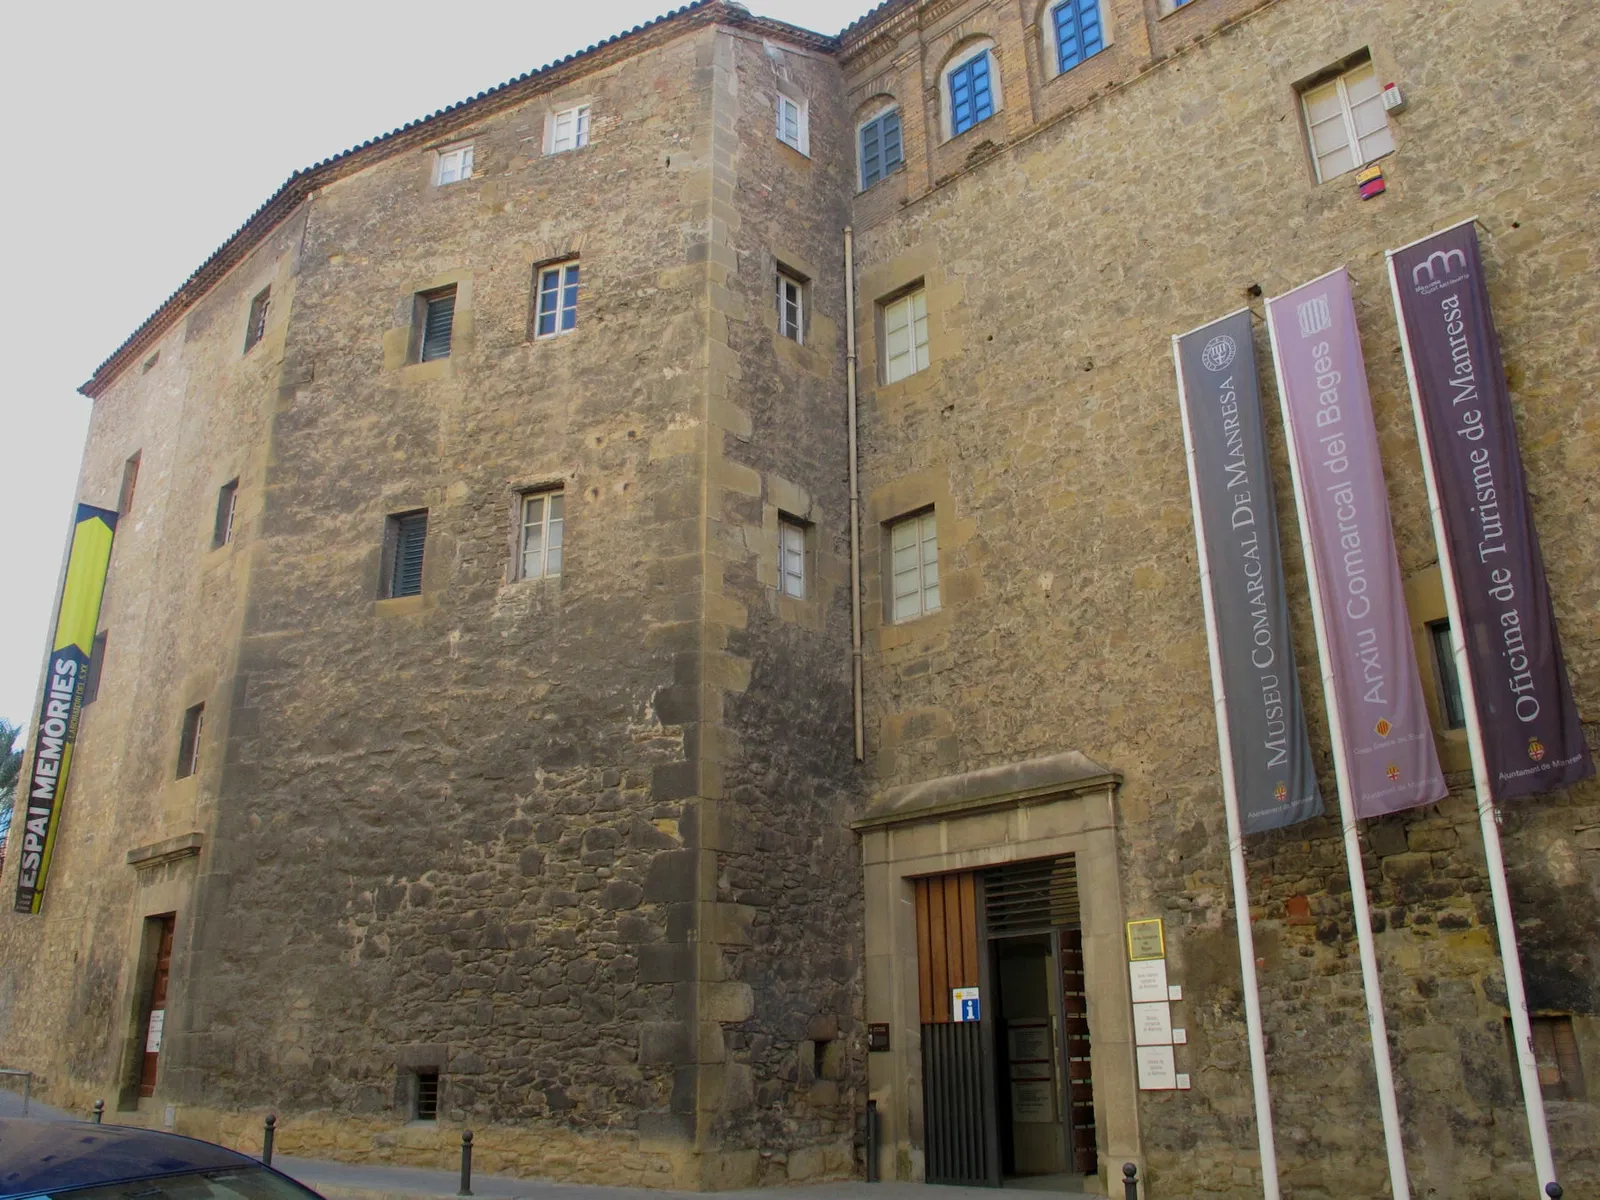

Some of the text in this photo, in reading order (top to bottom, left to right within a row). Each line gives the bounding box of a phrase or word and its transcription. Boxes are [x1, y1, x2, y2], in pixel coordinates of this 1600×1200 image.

[1312, 341, 1388, 705] Arxiu Comarcal del Bages
[1441, 293, 1540, 723] Oficina de Turisme de Manresa
[19, 657, 78, 889] ESPAI MEMÒRIES
[1499, 766, 1541, 781] Ajuntament
[1541, 763, 1551, 771] de
